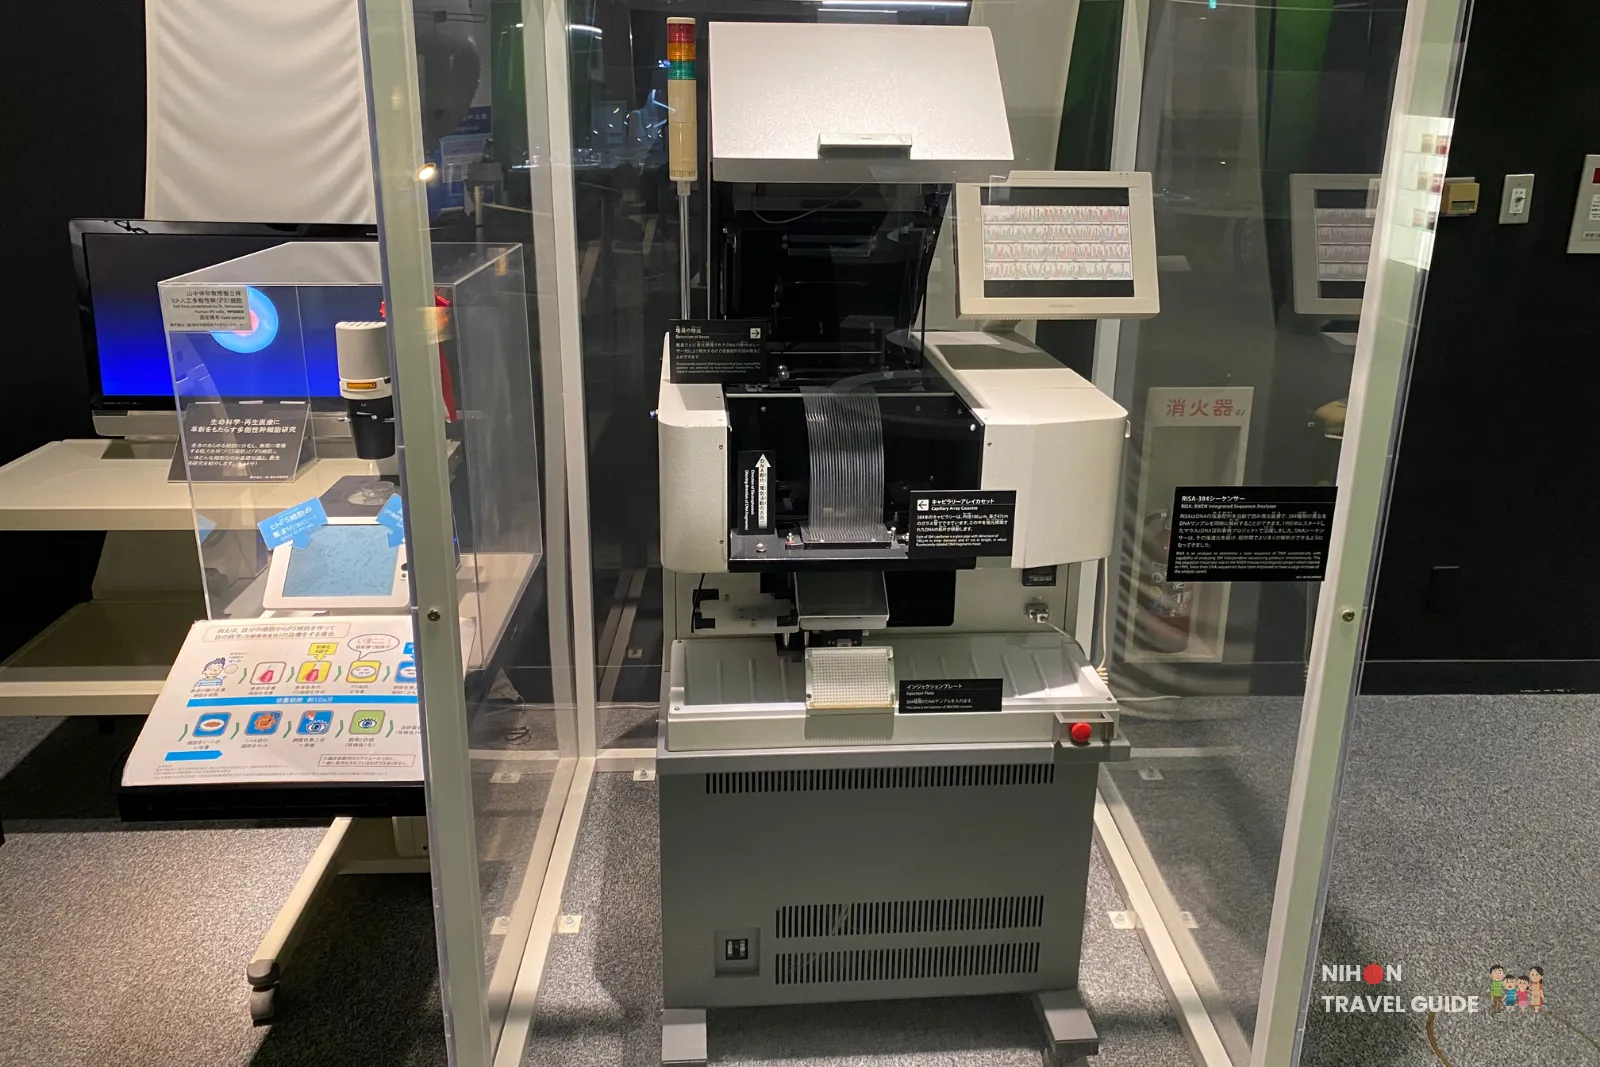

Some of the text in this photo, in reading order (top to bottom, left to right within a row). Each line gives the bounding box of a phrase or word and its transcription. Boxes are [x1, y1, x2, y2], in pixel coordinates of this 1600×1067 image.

[1166, 399, 1234, 417] 消火器
[190, 426, 297, 434] 革新をもたらす多能性幹細胞研究
